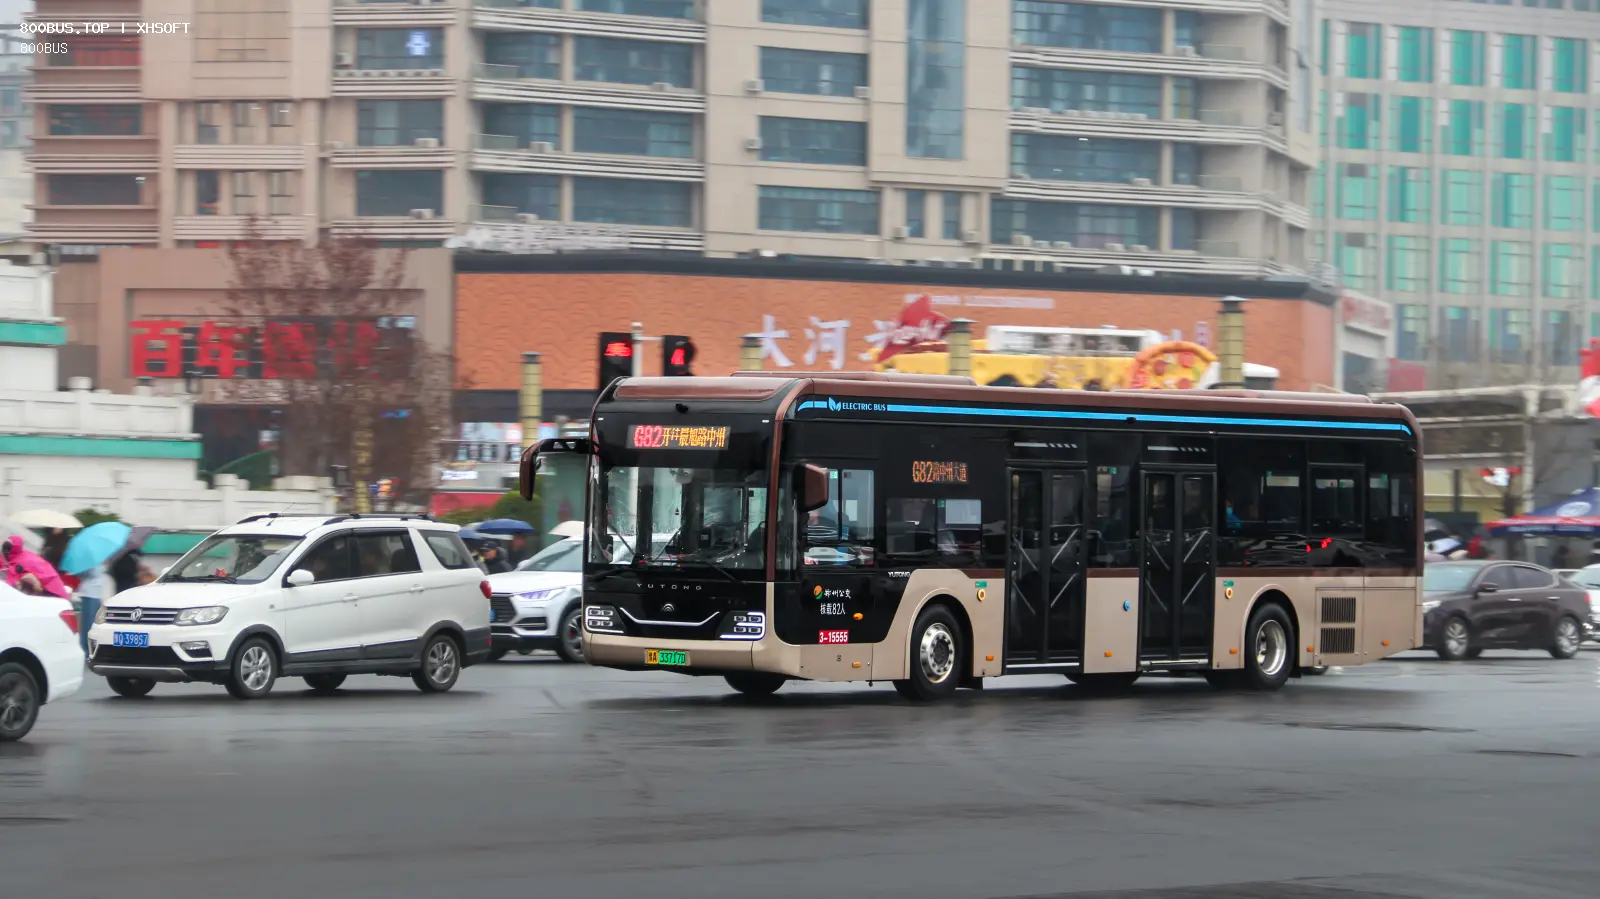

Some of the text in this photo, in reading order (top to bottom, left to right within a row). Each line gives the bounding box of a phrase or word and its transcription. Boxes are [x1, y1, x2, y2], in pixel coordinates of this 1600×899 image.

[842, 402, 886, 412] ELECTRIC BUS
[636, 583, 702, 591] YUTONG
[819, 631, 849, 643] 3-15555
